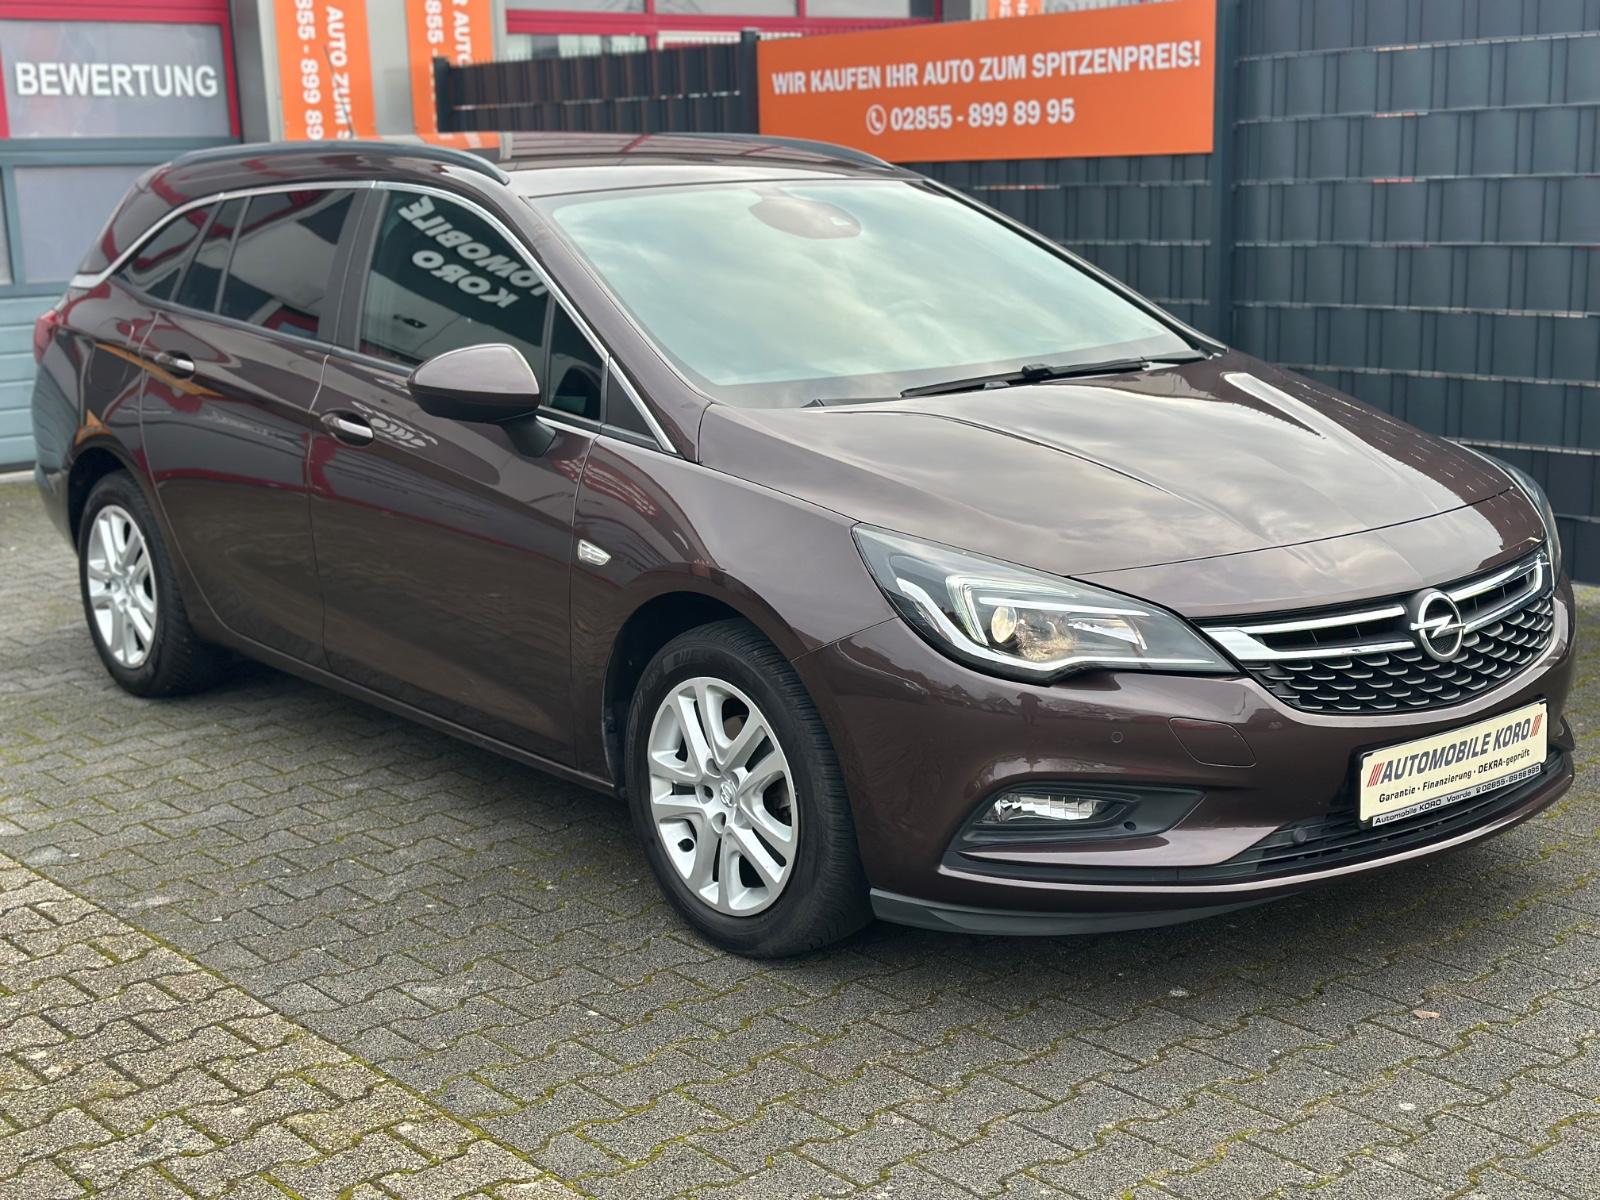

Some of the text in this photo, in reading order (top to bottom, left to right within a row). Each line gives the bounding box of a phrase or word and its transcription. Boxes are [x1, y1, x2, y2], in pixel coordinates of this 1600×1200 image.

[326, 6, 347, 67] AUTO
[15, 62, 218, 97] BEWERTUNG
[301, 59, 321, 103] 899
[772, 40, 1201, 94] WIR KAUFEN IHR AUTO ZUM SPITZENPREIS!
[332, 73, 351, 124] ZUM
[890, 105, 952, 131] 02855
[968, 102, 1007, 127] 899
[1013, 100, 1040, 125] 89
[1047, 98, 1075, 124] 95
[305, 110, 324, 140] 89
[1380, 718, 1531, 784] AUTOMOBILE KORO
[1379, 749, 1530, 803] Garantie Finanzierung DEKRA-geprüft
[1375, 807, 1417, 825] Automobile
[1419, 798, 1442, 812] KORO
